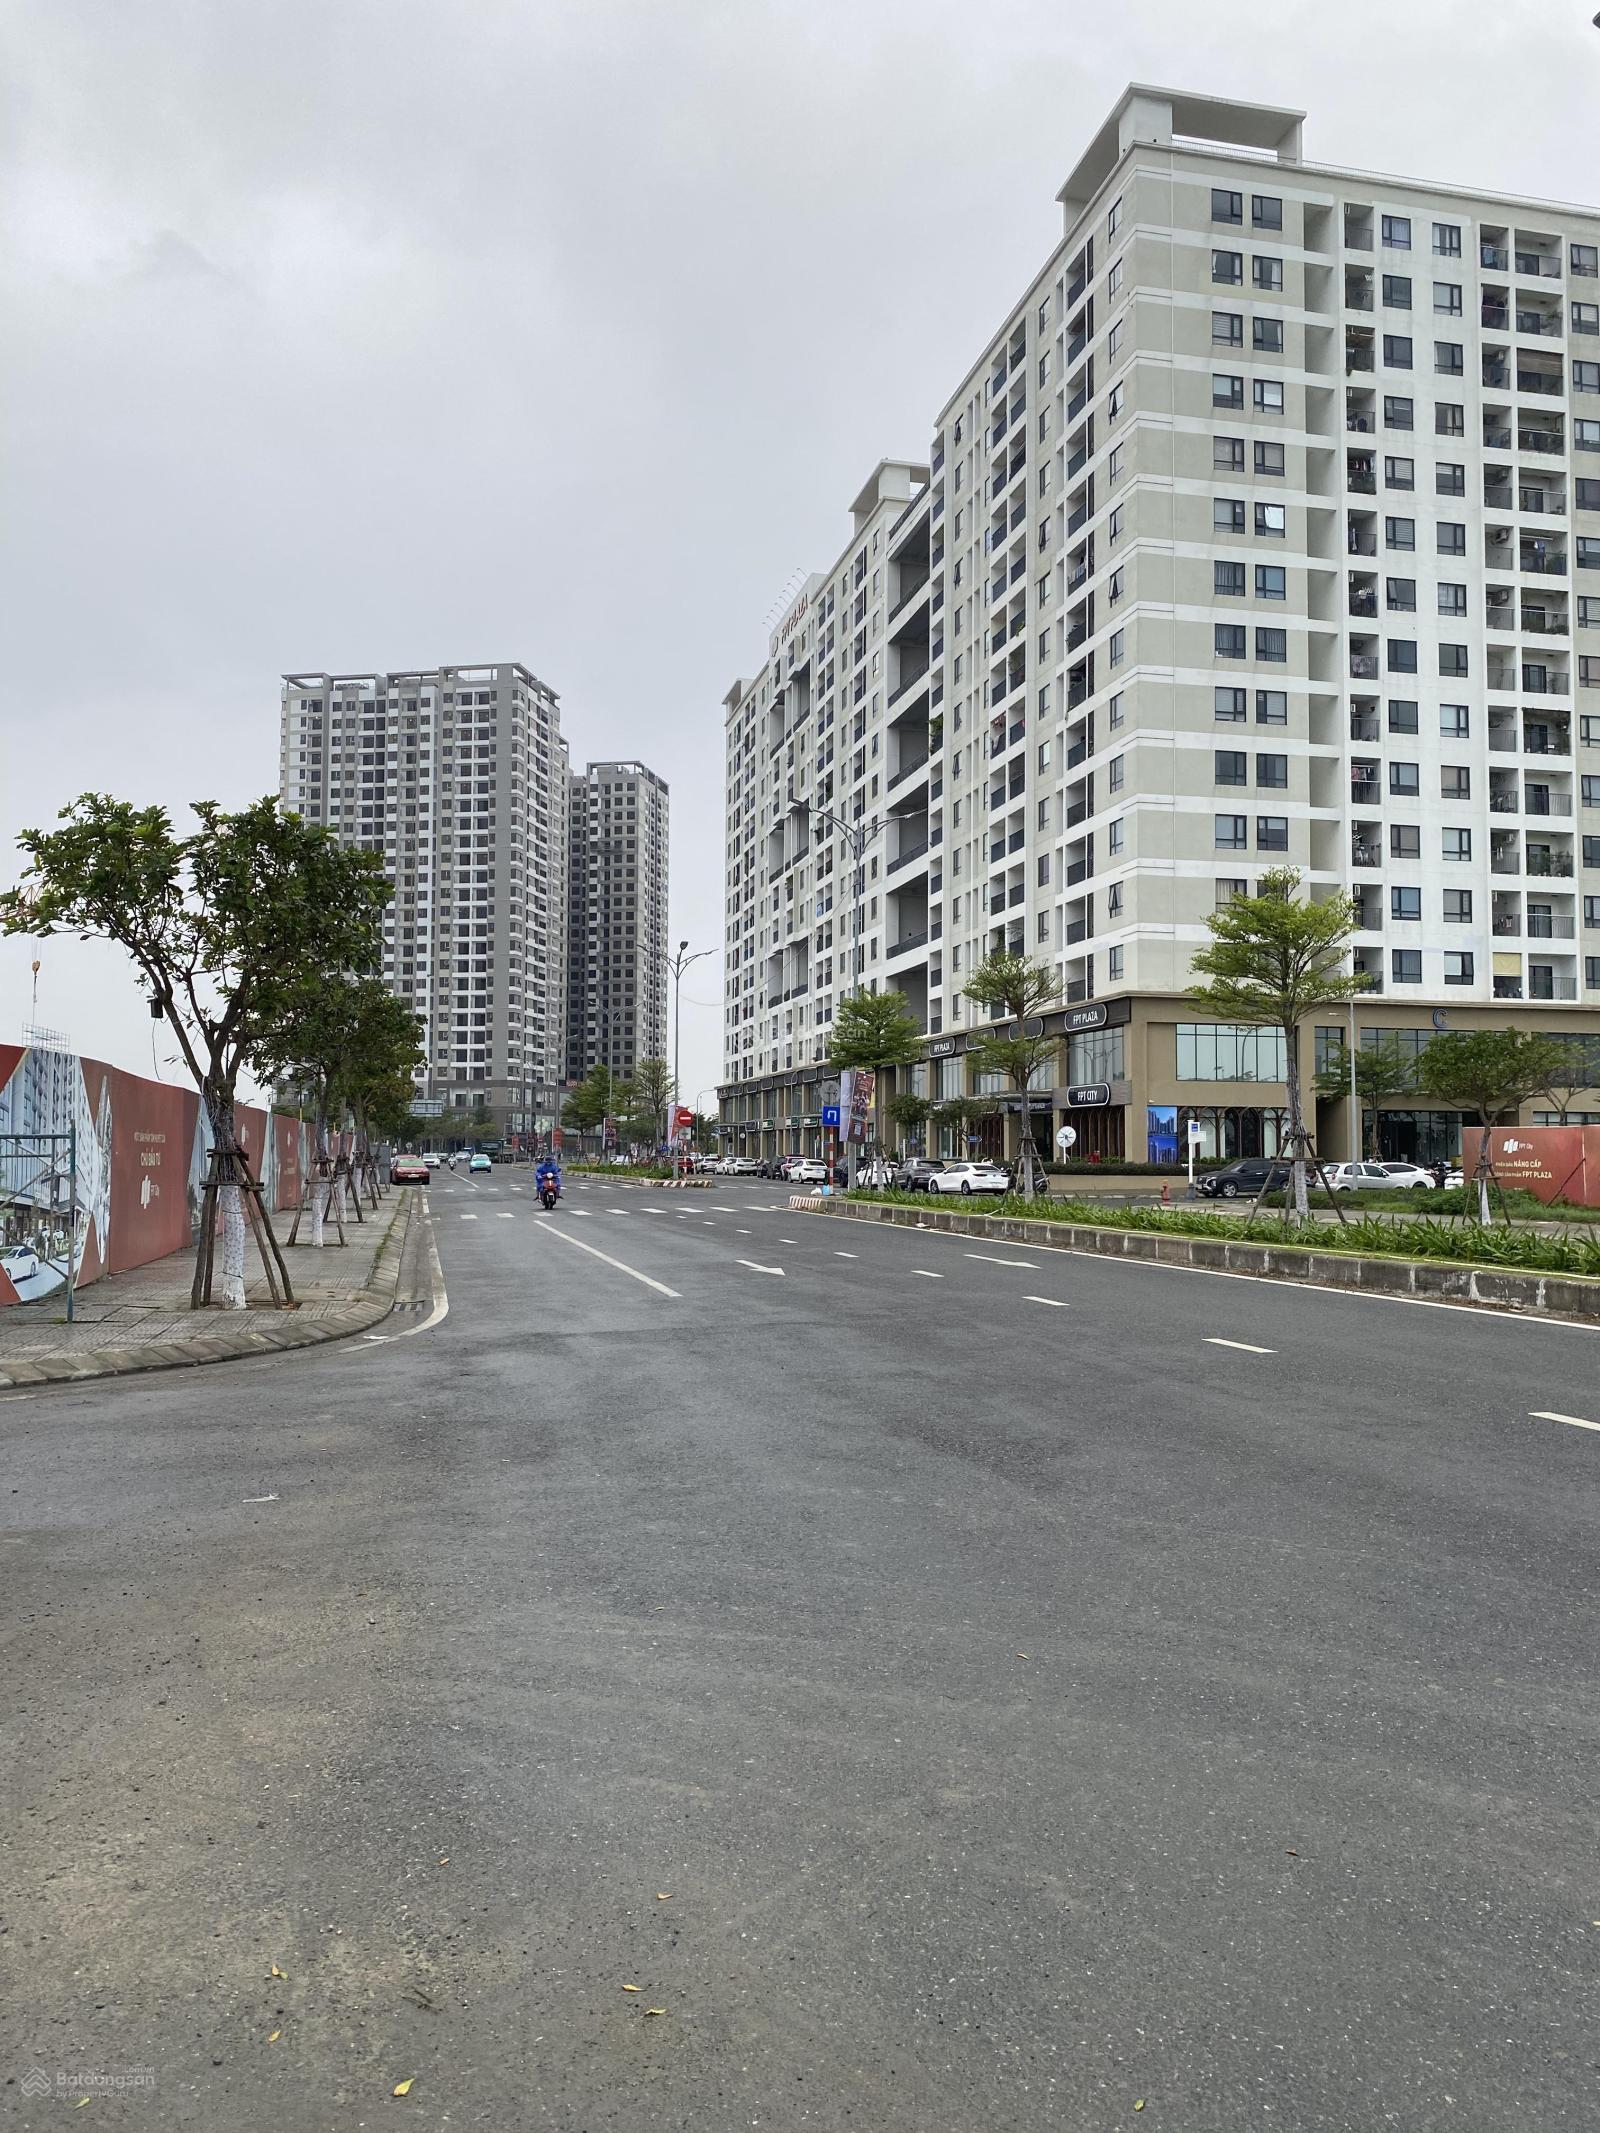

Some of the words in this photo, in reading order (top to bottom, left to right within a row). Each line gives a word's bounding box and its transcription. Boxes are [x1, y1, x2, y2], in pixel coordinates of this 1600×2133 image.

[1073, 1014, 1082, 1025] FPT
[1082, 1011, 1098, 1023] PLAZA
[1077, 1091, 1087, 1101] FPT
[1087, 1090, 1098, 1101] CITY
